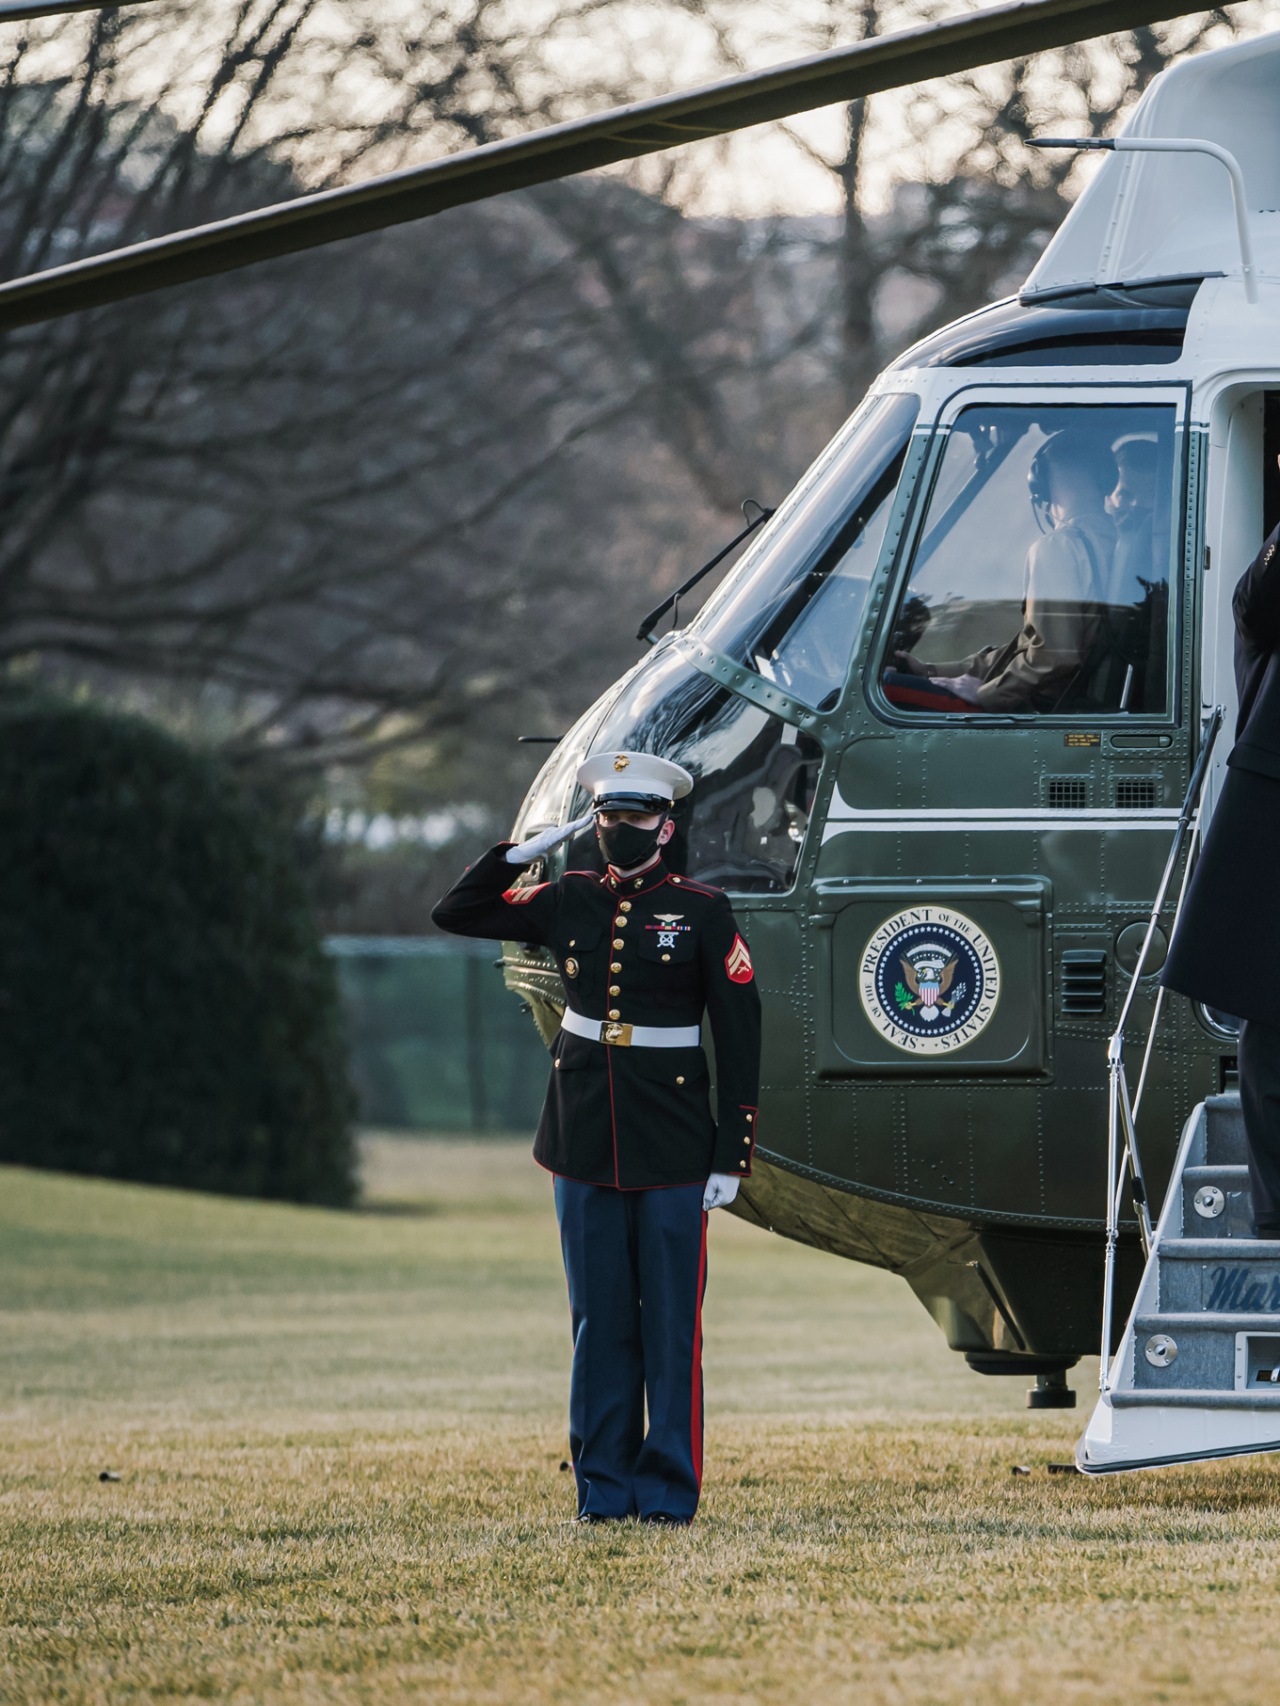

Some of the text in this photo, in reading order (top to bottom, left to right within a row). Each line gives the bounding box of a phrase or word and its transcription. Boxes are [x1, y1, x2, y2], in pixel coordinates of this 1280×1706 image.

[862, 909, 997, 1050] SEAL OF THE PRESIDENT OF THE UNITED STATES
